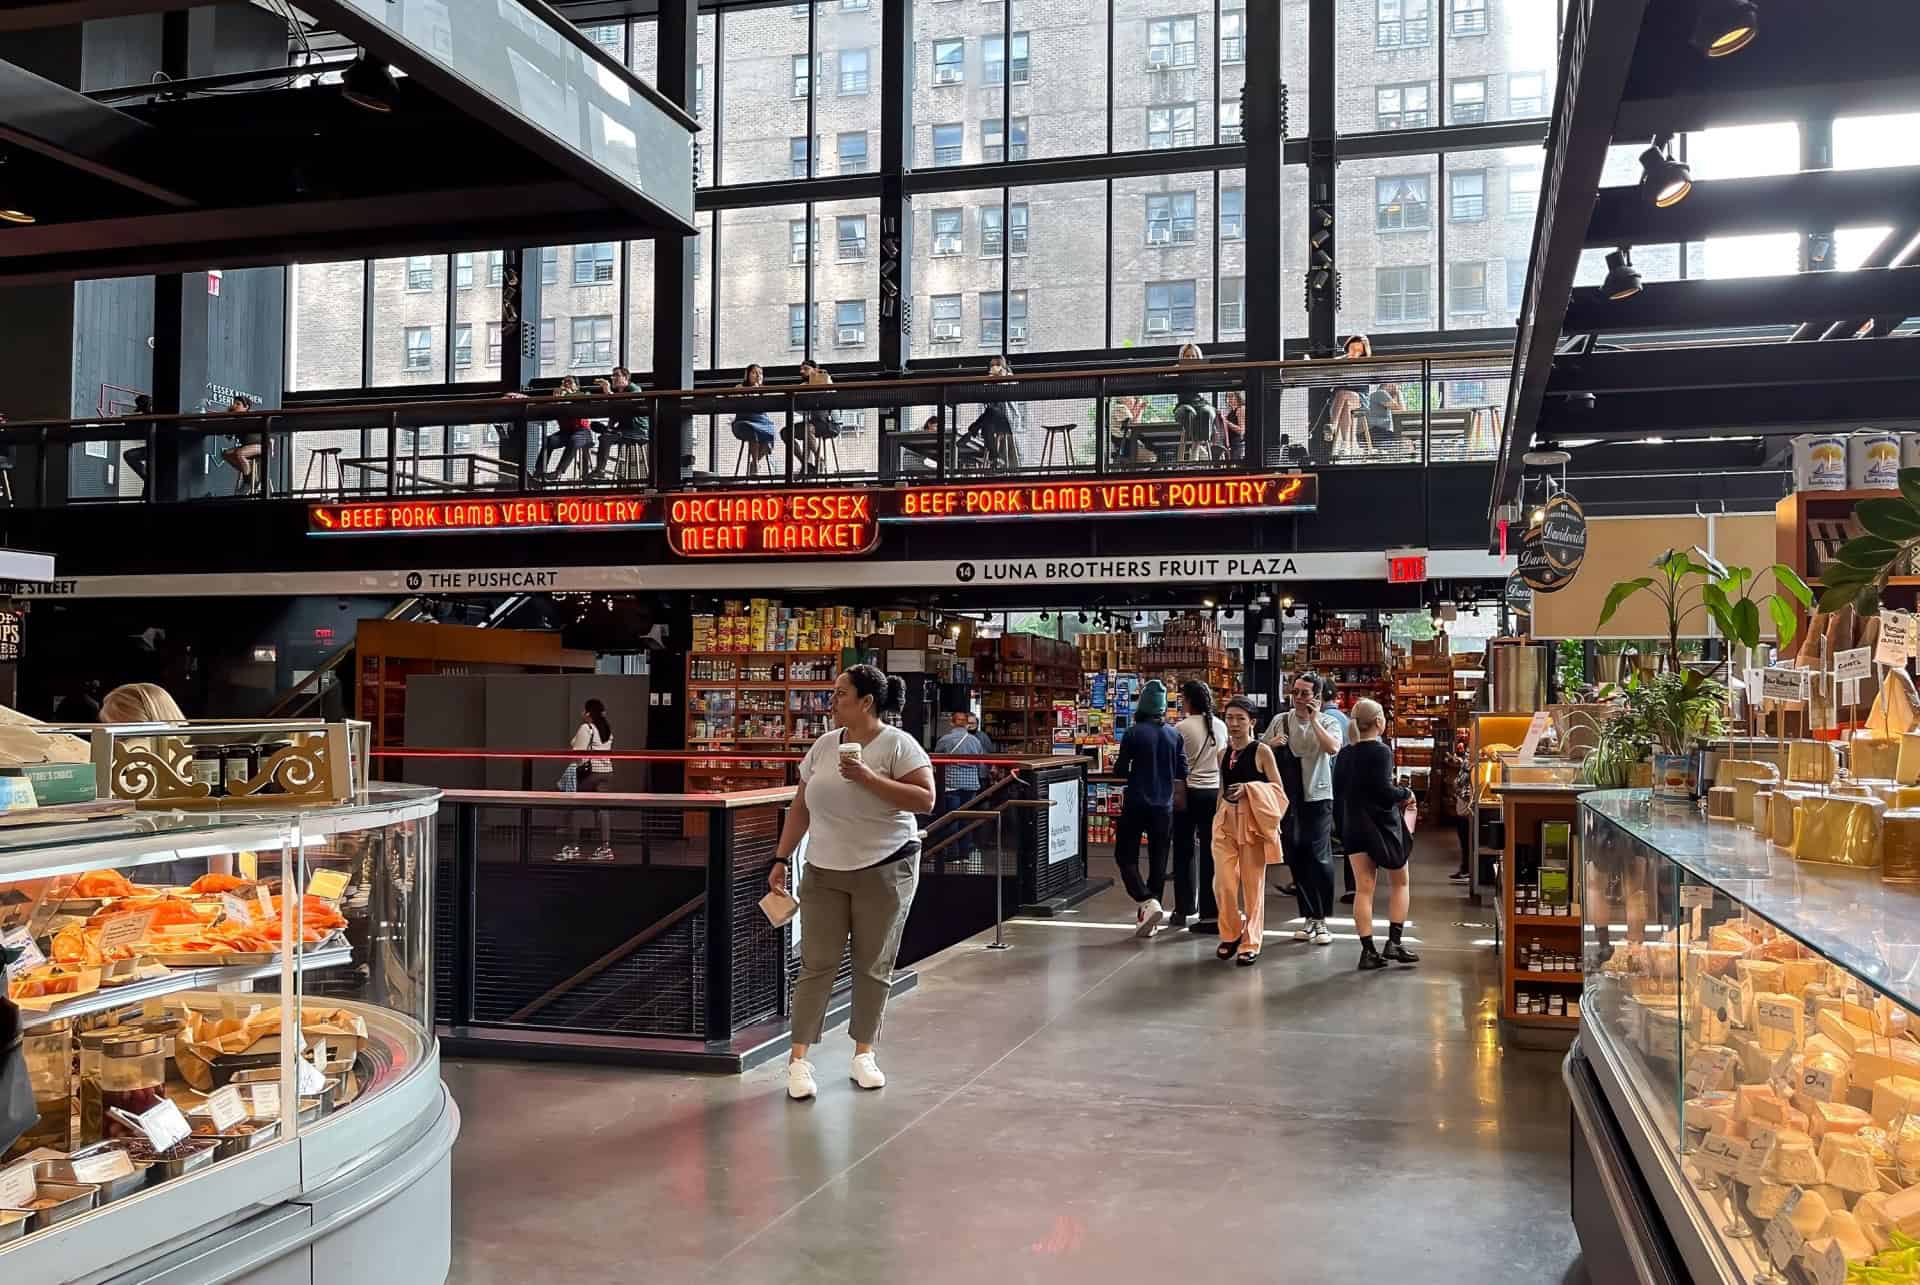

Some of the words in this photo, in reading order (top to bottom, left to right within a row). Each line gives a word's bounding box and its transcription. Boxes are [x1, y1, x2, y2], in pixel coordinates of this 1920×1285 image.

[213, 384, 234, 397] ESSEX
[671, 498, 779, 522] ORCHARD
[792, 496, 866, 519] ESSEX
[904, 491, 957, 514] BEEF
[966, 489, 1022, 512] PORK
[1031, 487, 1091, 511] LAMB
[1102, 484, 1160, 508] VEAL
[1169, 481, 1268, 506] POULTRY
[341, 507, 384, 528] BEEF
[392, 506, 436, 527] PORK
[444, 504, 494, 525] LAMB
[502, 503, 550, 523] VEAL
[557, 501, 639, 522] POULTRY
[682, 525, 747, 550] MEAT
[762, 524, 864, 549] MARKET
[984, 562, 1037, 579] LUNA
[1046, 560, 1150, 578] BROTHERS
[1160, 559, 1219, 576] FRUIT
[1228, 558, 1297, 576] PLAZA
[1520, 550, 1549, 567] Davi
[430, 574, 461, 587] THE
[468, 572, 558, 587] PUSHCART
